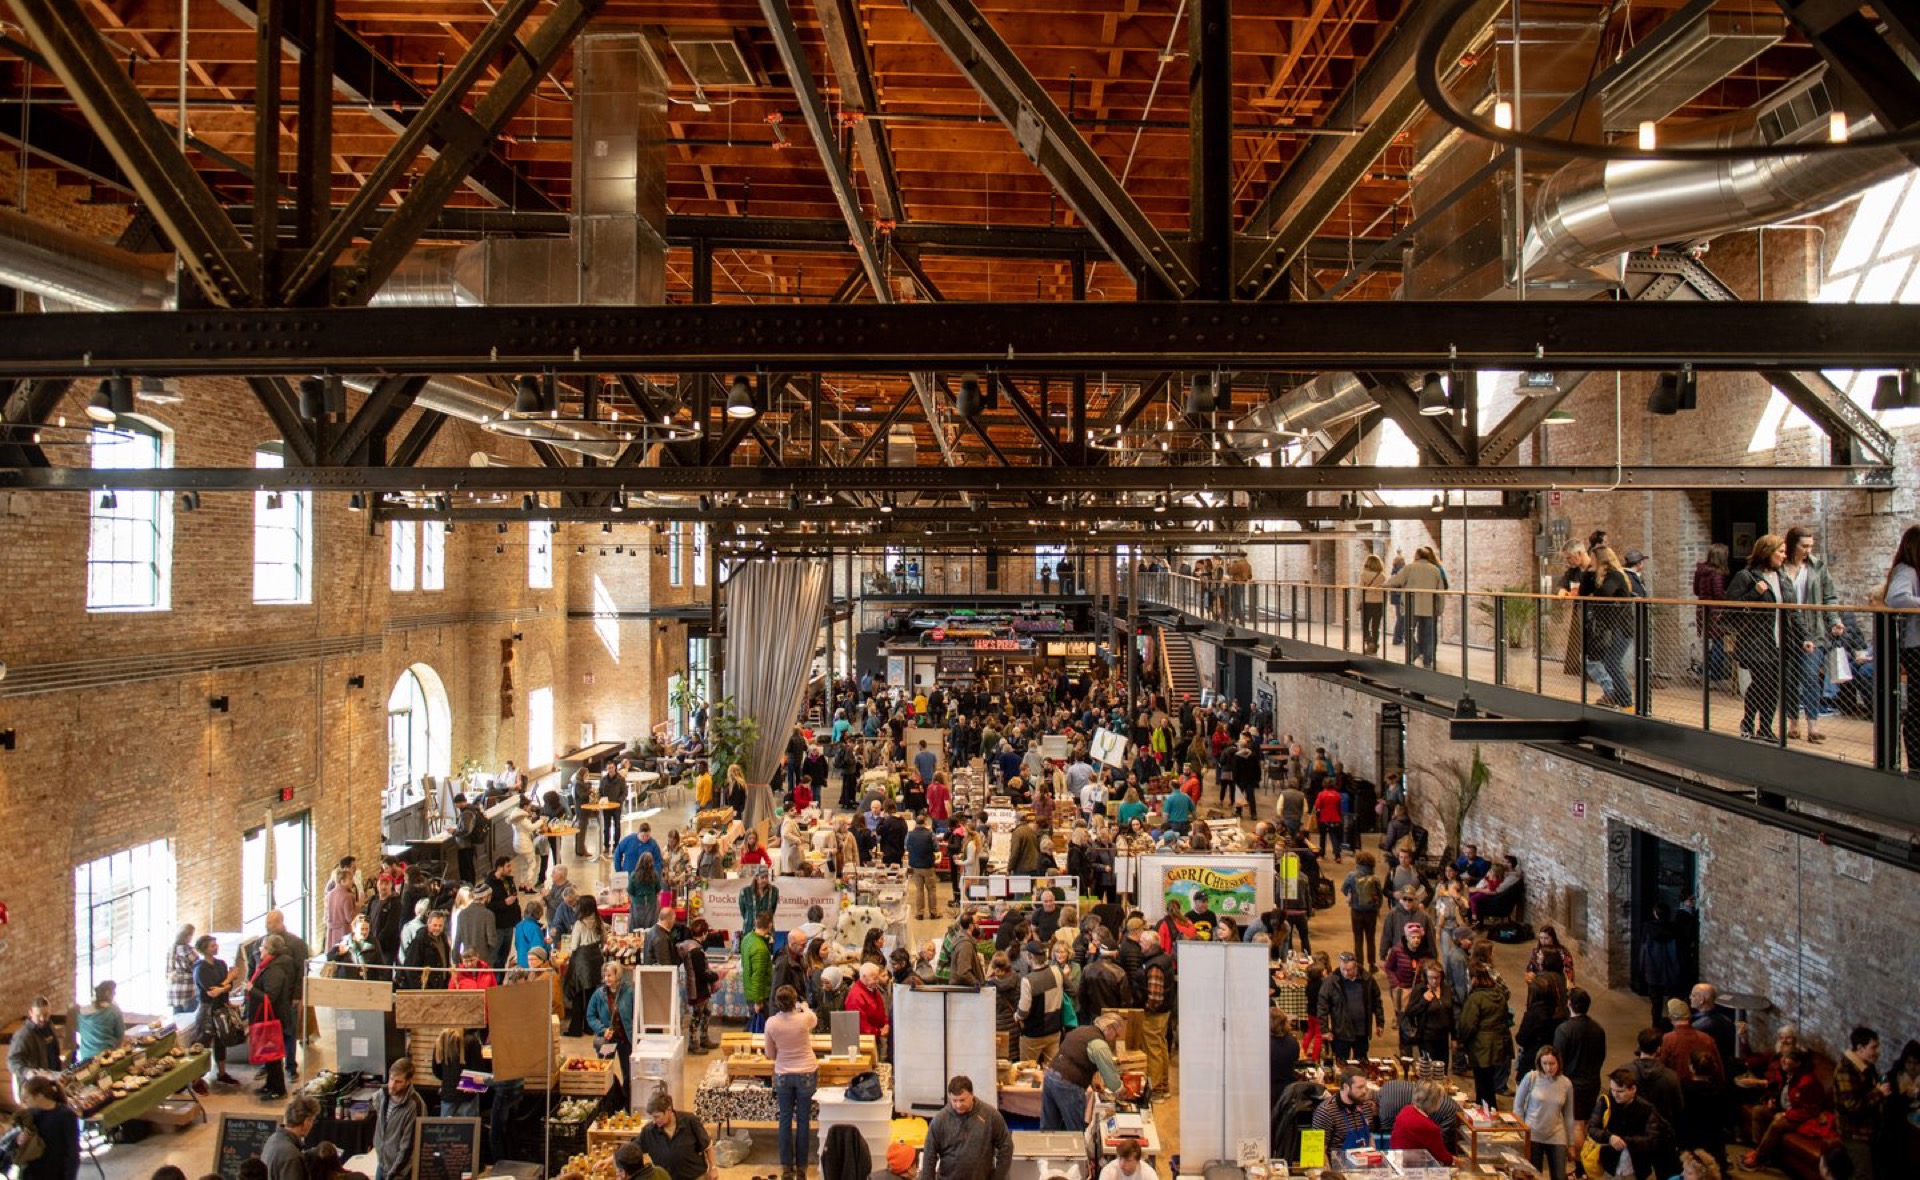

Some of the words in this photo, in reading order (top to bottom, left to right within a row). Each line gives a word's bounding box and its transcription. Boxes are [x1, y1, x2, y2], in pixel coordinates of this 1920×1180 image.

[500, 638, 514, 720] BAR
[1167, 868, 1205, 882] CAPRI
[1204, 871, 1248, 889] CHEESERY
[708, 894, 737, 904] Ducks
[778, 895, 809, 906] Family
[810, 896, 834, 905] Farm
